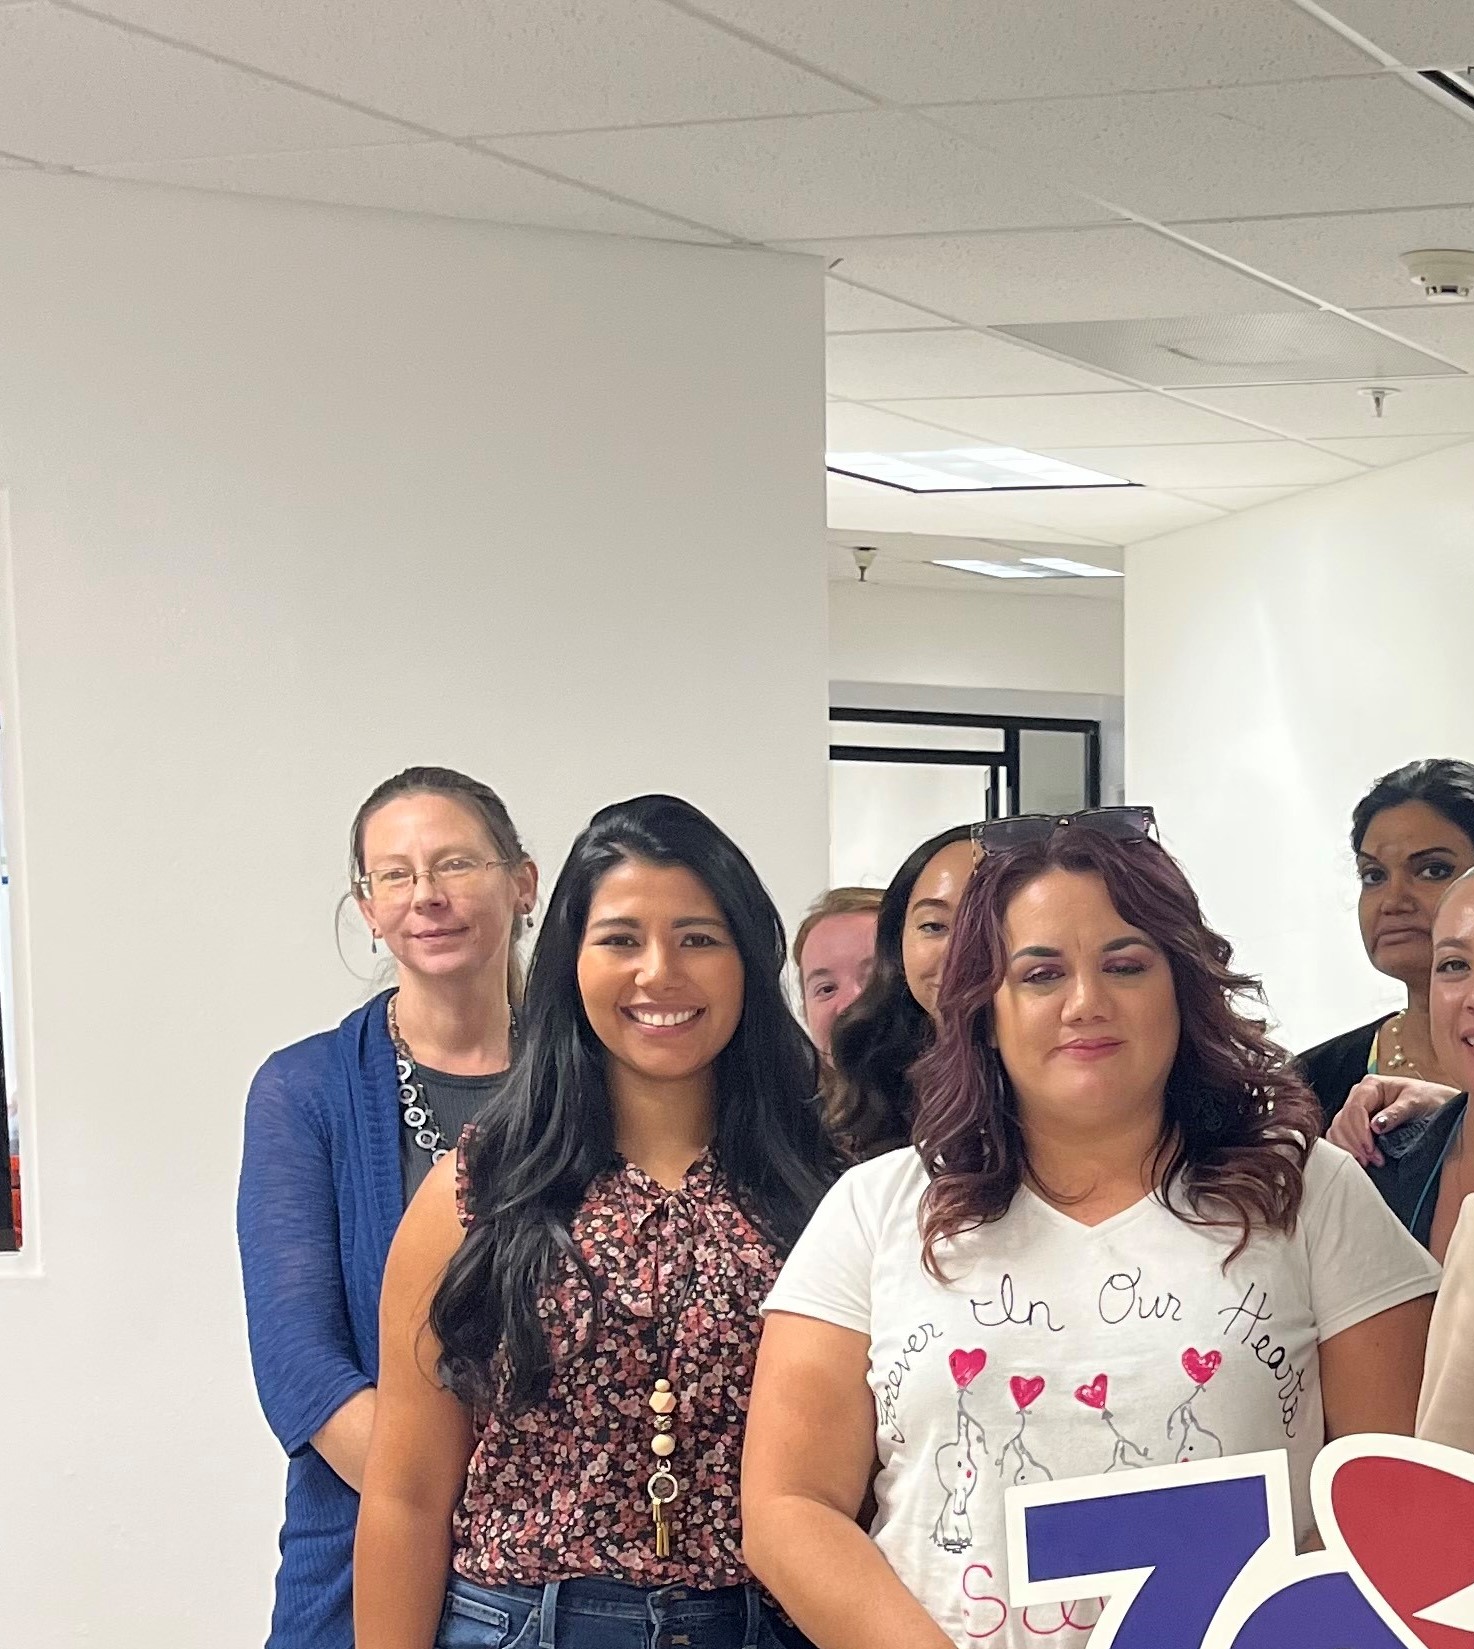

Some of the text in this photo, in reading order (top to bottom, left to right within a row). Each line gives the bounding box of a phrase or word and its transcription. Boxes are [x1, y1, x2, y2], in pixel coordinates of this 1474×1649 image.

[970, 1273, 1065, 1331] In
[1099, 1267, 1181, 1324] Our
[1218, 1282, 1304, 1438] Hearts
